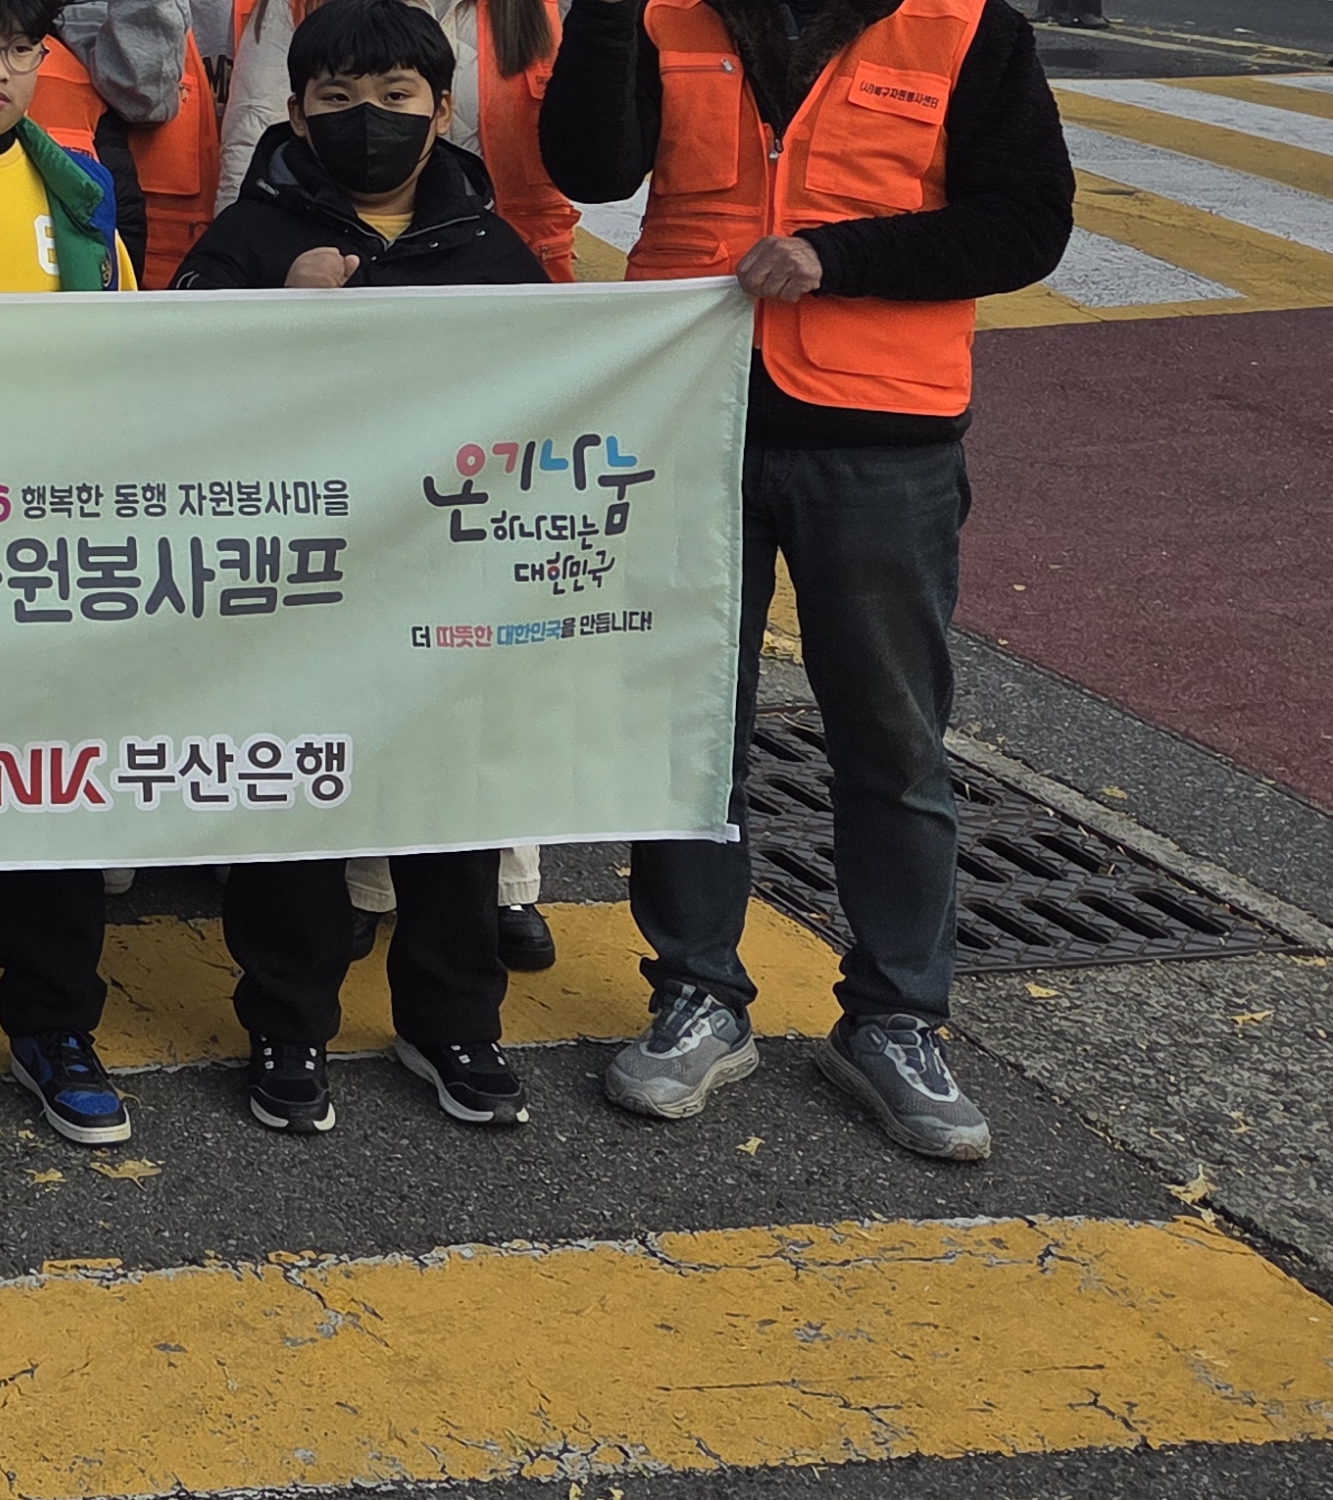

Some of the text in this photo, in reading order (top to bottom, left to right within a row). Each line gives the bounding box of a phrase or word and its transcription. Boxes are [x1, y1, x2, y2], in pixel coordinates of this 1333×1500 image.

[21, 483, 103, 519] 행복한
[114, 480, 167, 518] 동행
[178, 479, 350, 517] 자원봉사마을
[490, 510, 599, 550] 하나되는
[514, 551, 616, 595] 대한민국
[411, 610, 654, 649] 더 따뜻한 대한민국을 만듭니다!
[117, 739, 348, 805] 부산은행
